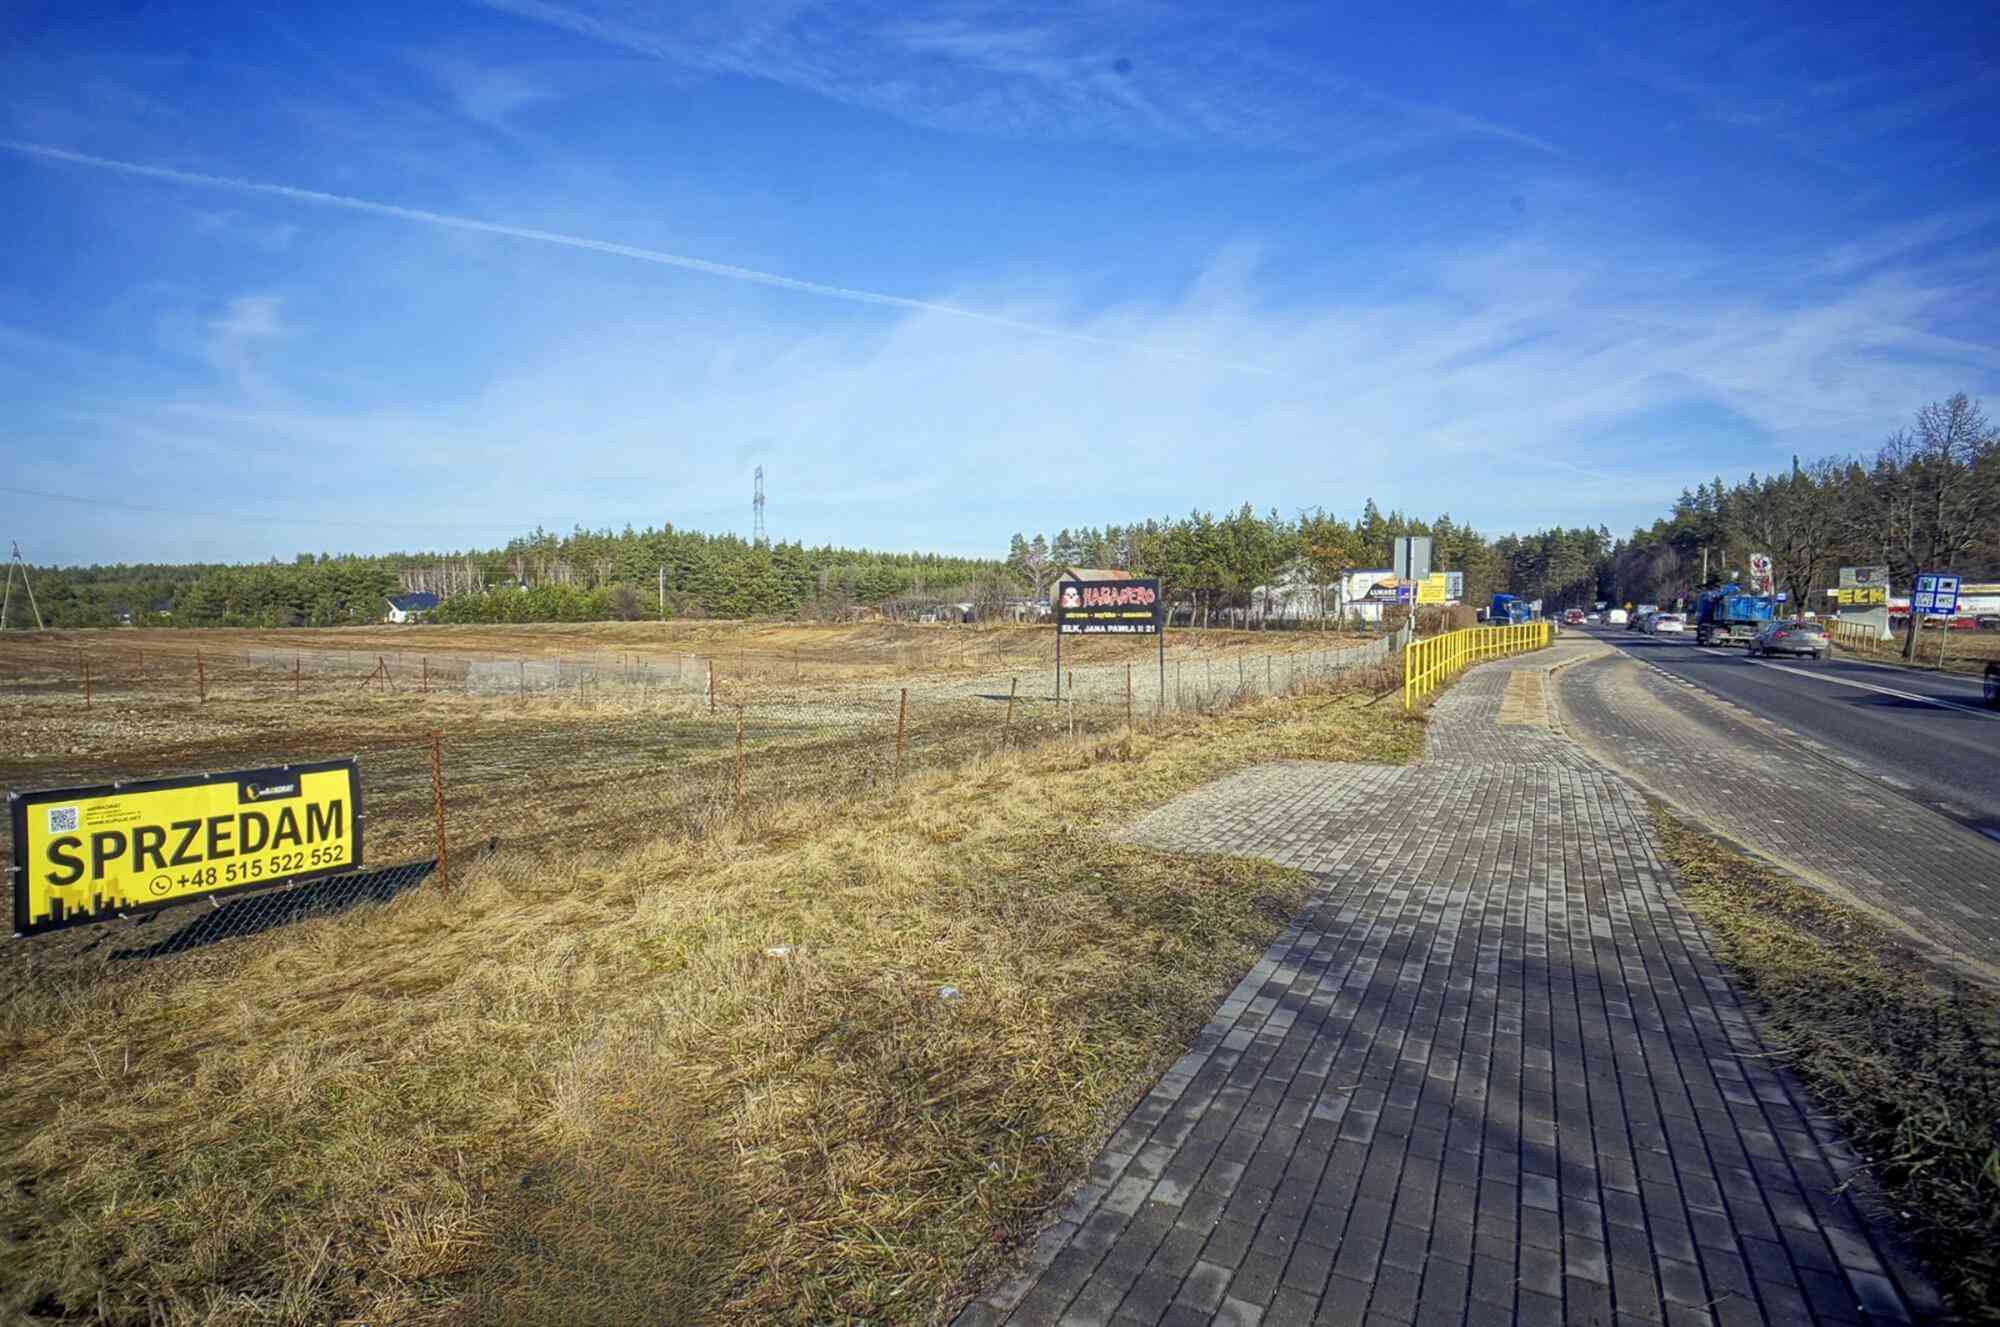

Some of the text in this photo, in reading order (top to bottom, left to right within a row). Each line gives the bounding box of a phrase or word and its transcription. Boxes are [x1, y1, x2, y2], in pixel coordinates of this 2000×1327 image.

[1144, 624, 1156, 633] 21
[45, 800, 344, 887] SPRZEDAM
[177, 845, 344, 888] +48 515 522 552
